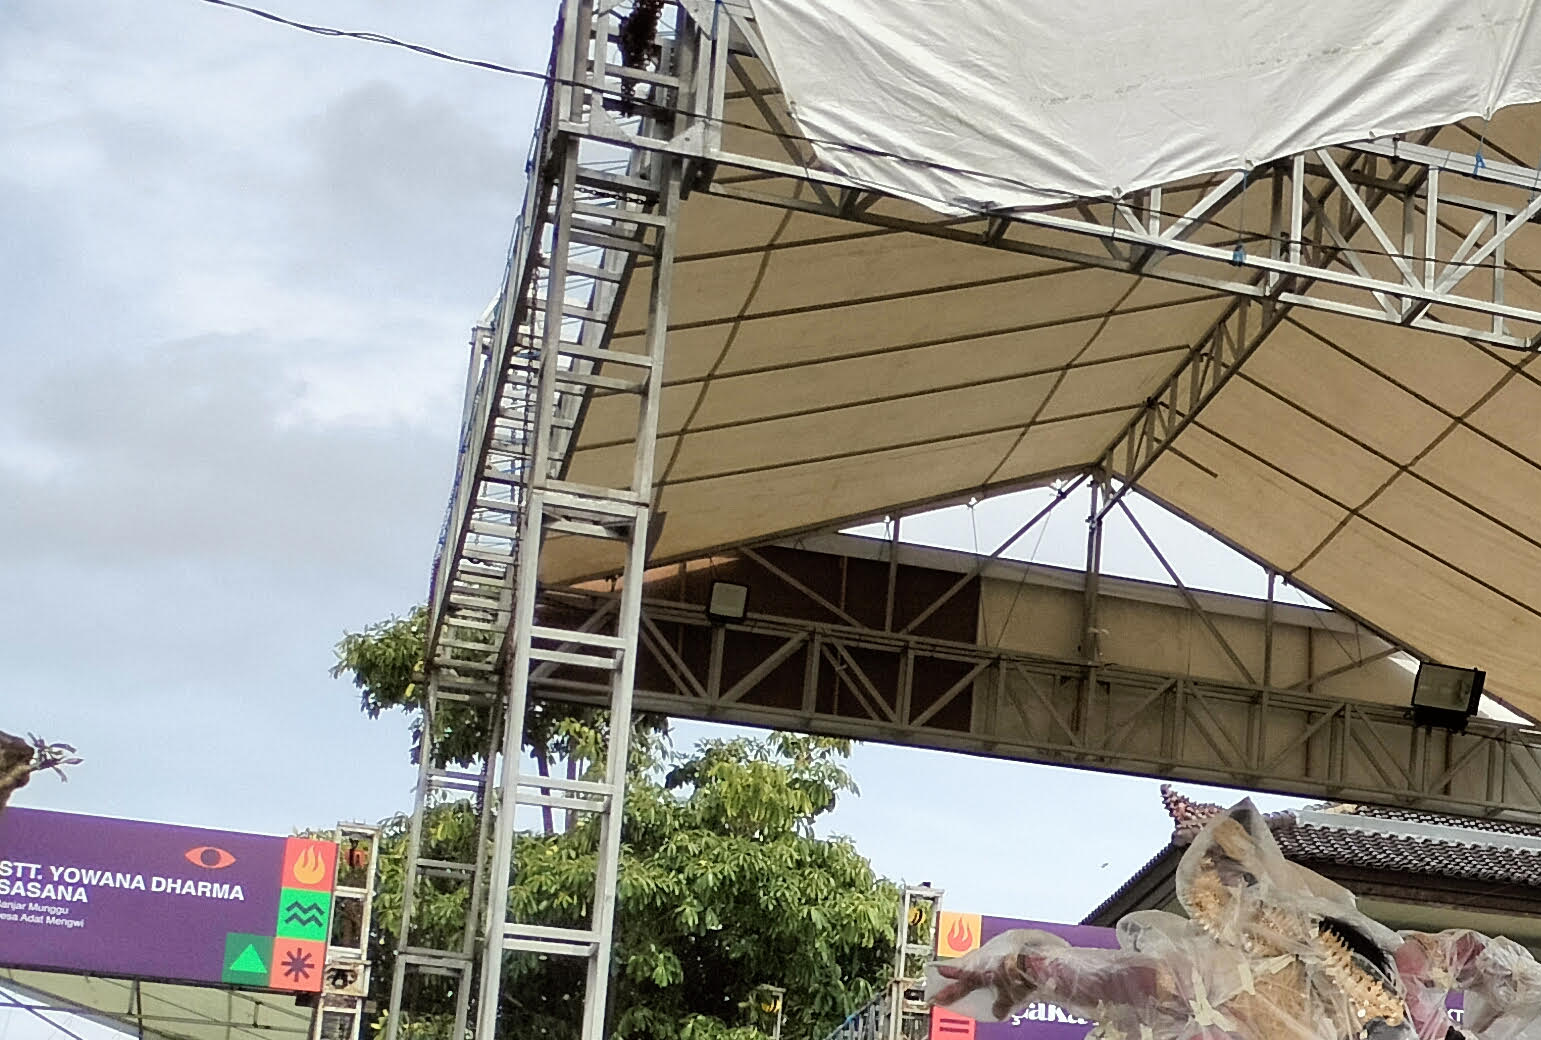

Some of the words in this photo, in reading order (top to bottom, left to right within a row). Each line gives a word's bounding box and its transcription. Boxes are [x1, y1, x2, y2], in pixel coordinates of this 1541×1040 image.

[0, 860, 42, 880] STT.
[50, 865, 145, 890] YOWANA
[151, 876, 244, 901] DHARMA
[0, 878, 88, 903] SASANA
[0, 901, 26, 911] anjar
[0, 913, 18, 921] esa
